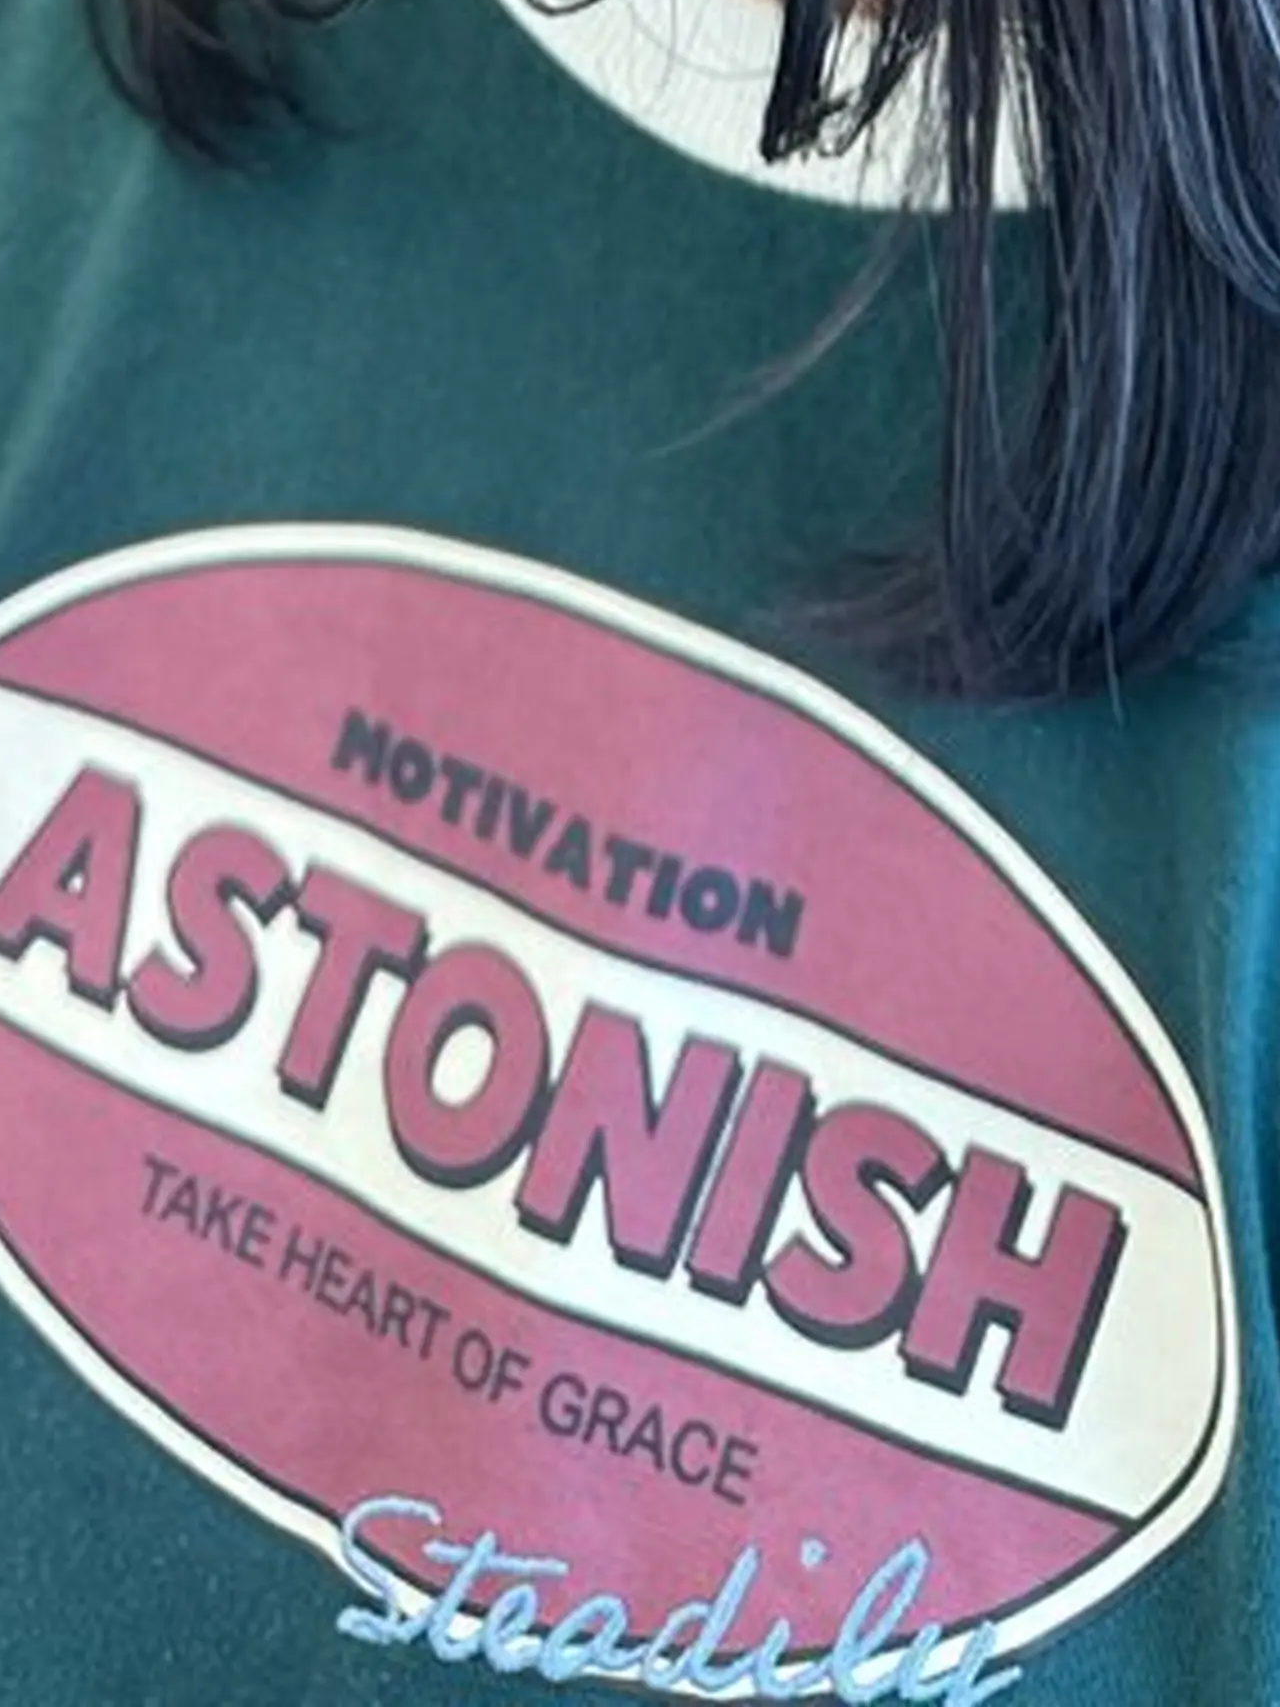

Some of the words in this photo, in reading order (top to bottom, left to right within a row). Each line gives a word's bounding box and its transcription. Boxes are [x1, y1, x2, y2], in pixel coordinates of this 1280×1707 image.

[333, 709, 805, 958] MOTIVATION
[140, 1158, 275, 1272] TAKE
[277, 1230, 451, 1359] HEART
[452, 1326, 531, 1405] OF
[538, 1371, 761, 1505] GRACE
[336, 1495, 1023, 1707] Steadily
